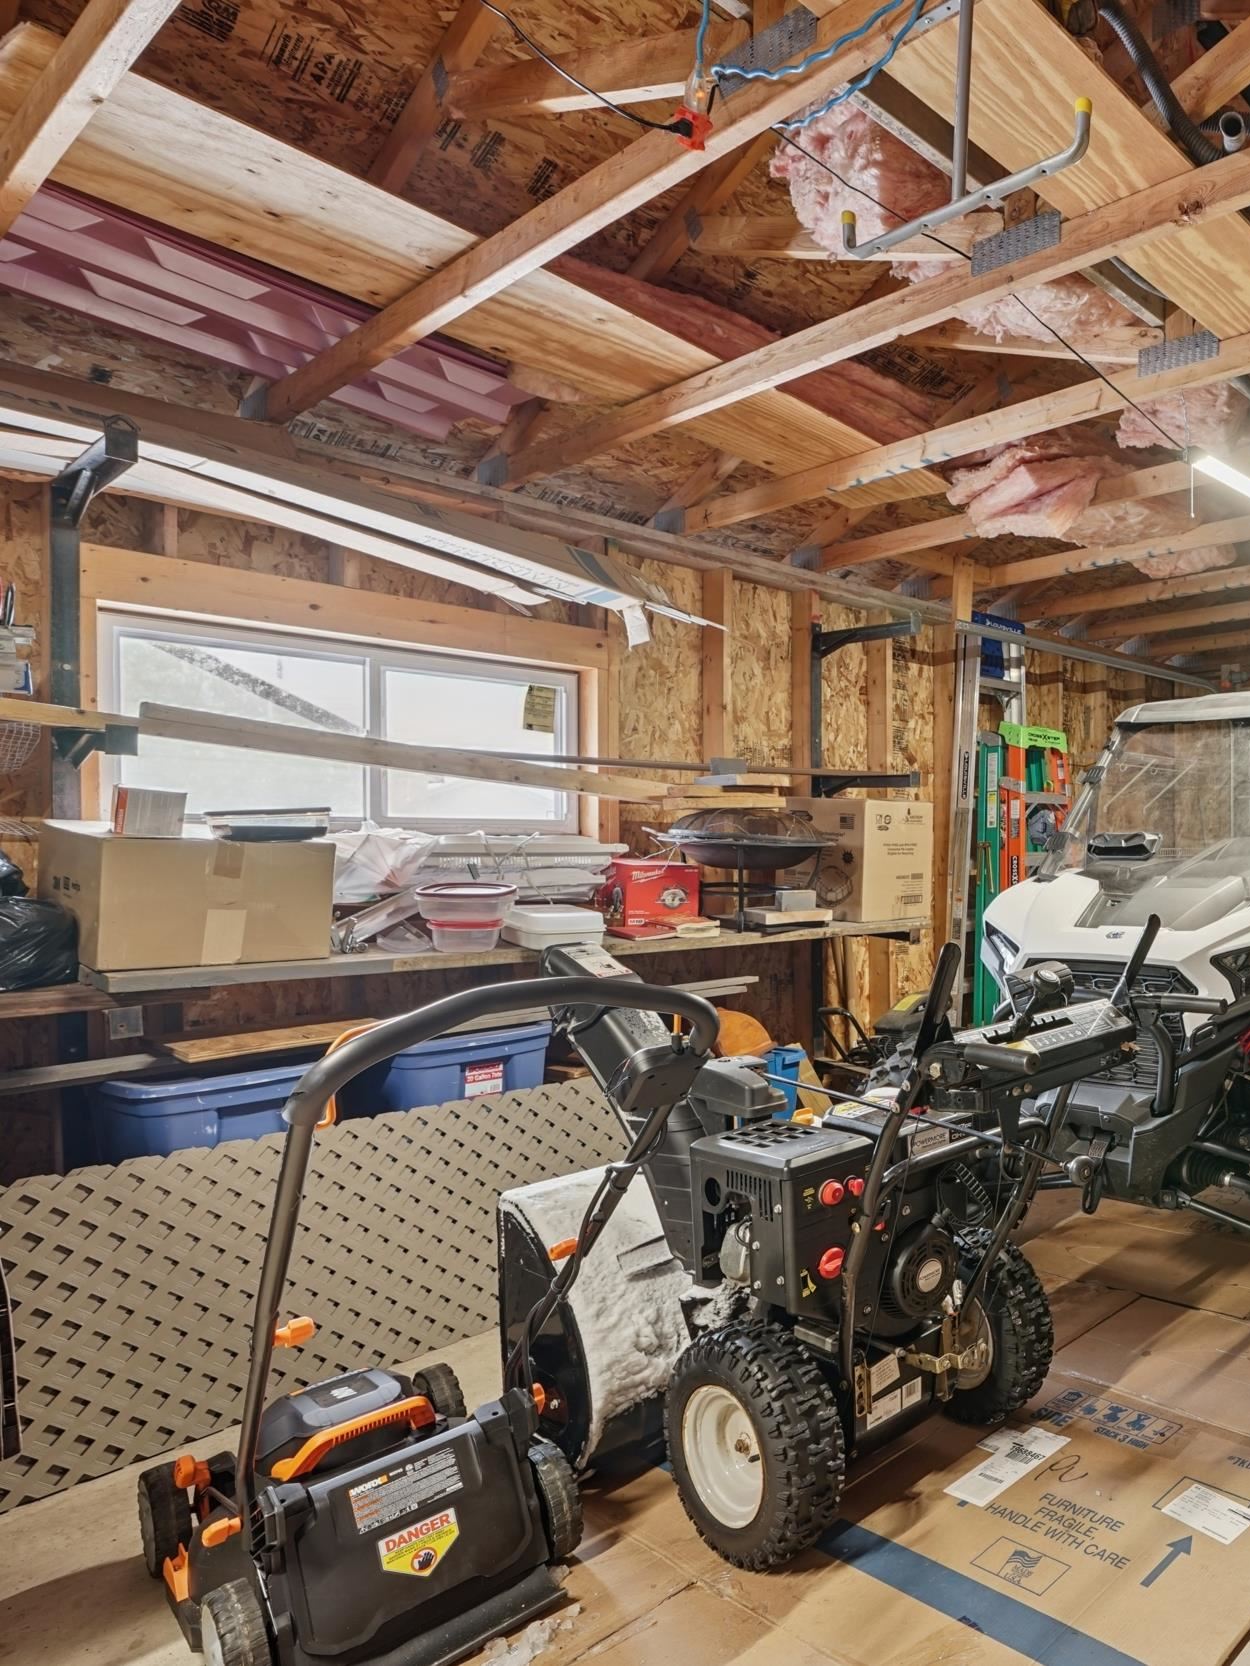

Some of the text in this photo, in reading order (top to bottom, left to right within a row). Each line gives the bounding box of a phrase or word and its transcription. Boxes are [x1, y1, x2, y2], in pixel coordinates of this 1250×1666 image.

[310, 53, 338, 86] APA
[991, 621, 1021, 634] LOUISVILLE
[1094, 1426, 1118, 1442] STACK
[1127, 1437, 1150, 1450] HIGH
[1033, 1506, 1099, 1540] FRAGILE,
[1039, 1492, 1125, 1532] FURNITURE
[384, 1513, 451, 1553] DANGER
[984, 1503, 1131, 1570] HANDLE WITH CARE
